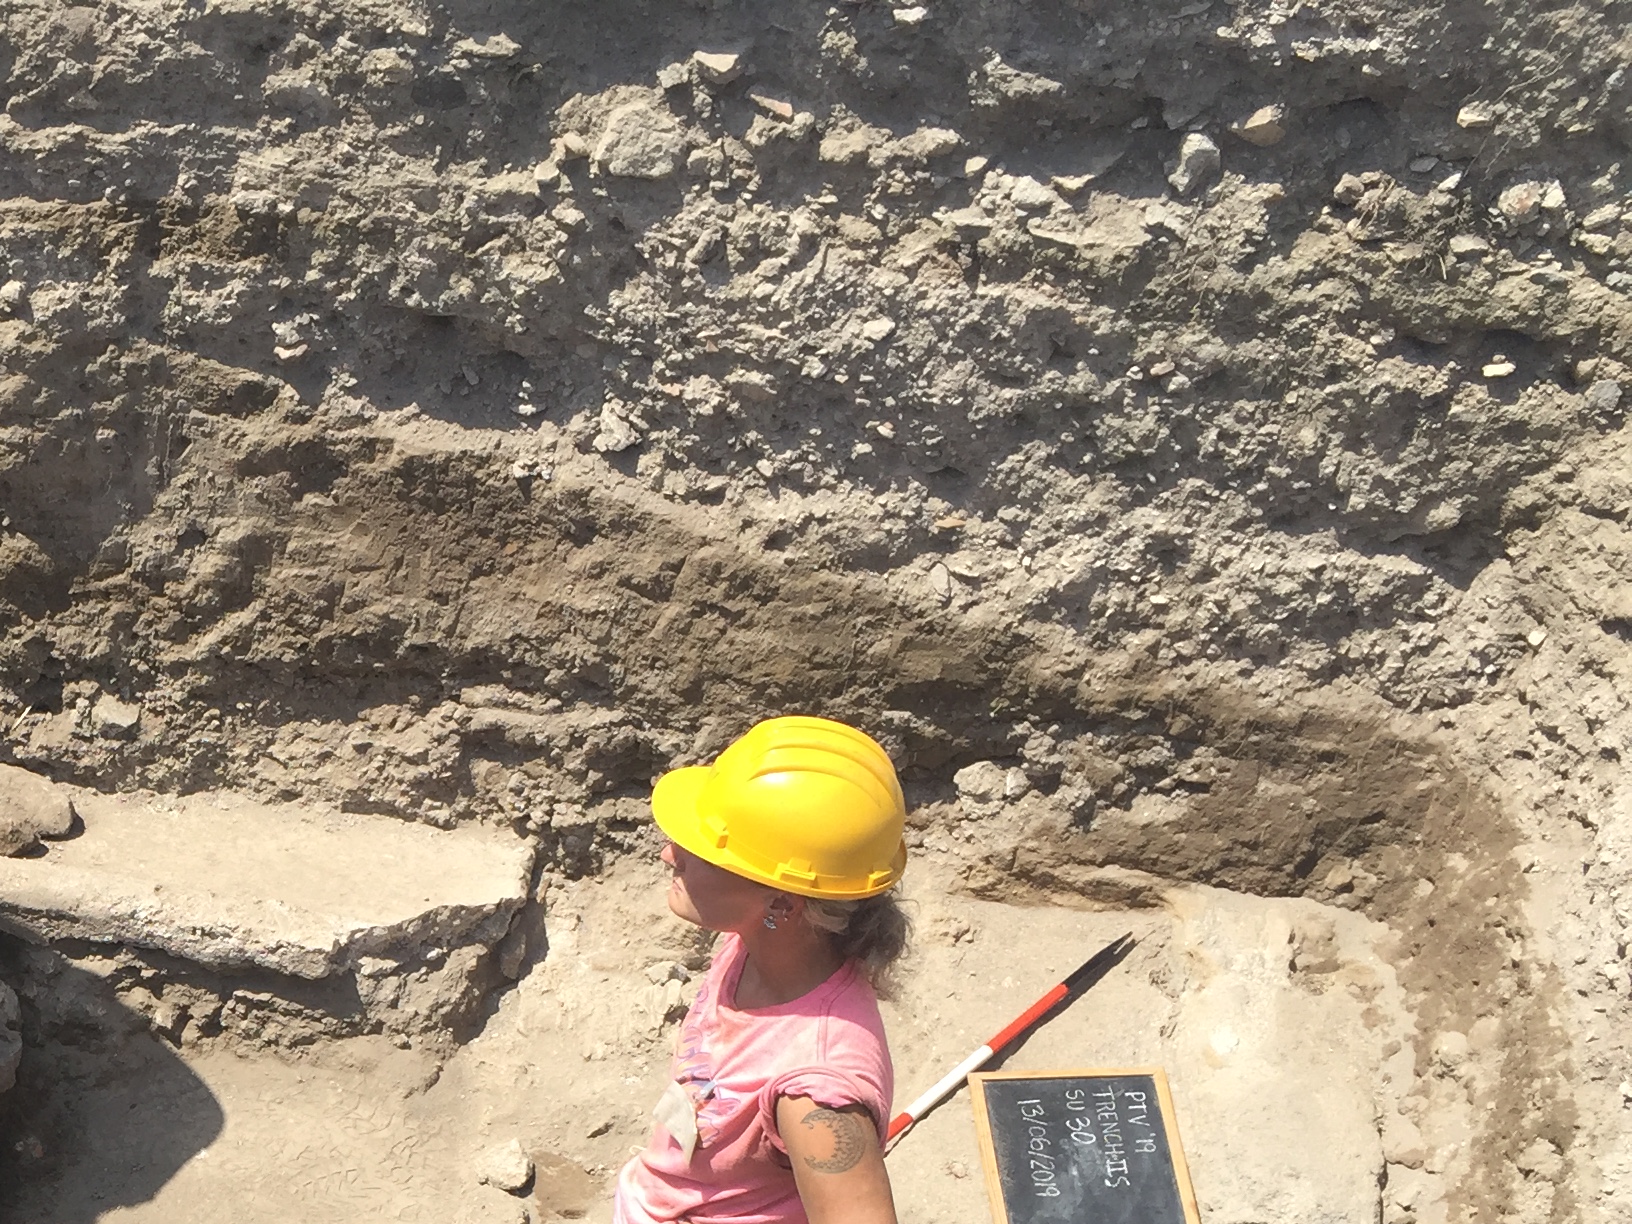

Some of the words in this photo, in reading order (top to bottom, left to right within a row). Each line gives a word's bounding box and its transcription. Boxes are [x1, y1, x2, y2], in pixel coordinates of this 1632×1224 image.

[1064, 1089, 1086, 1111] SU
[1124, 1091, 1150, 1127] PTV
[1066, 1116, 1097, 1145] 30
[1016, 1098, 1062, 1198] 13/06/2019
